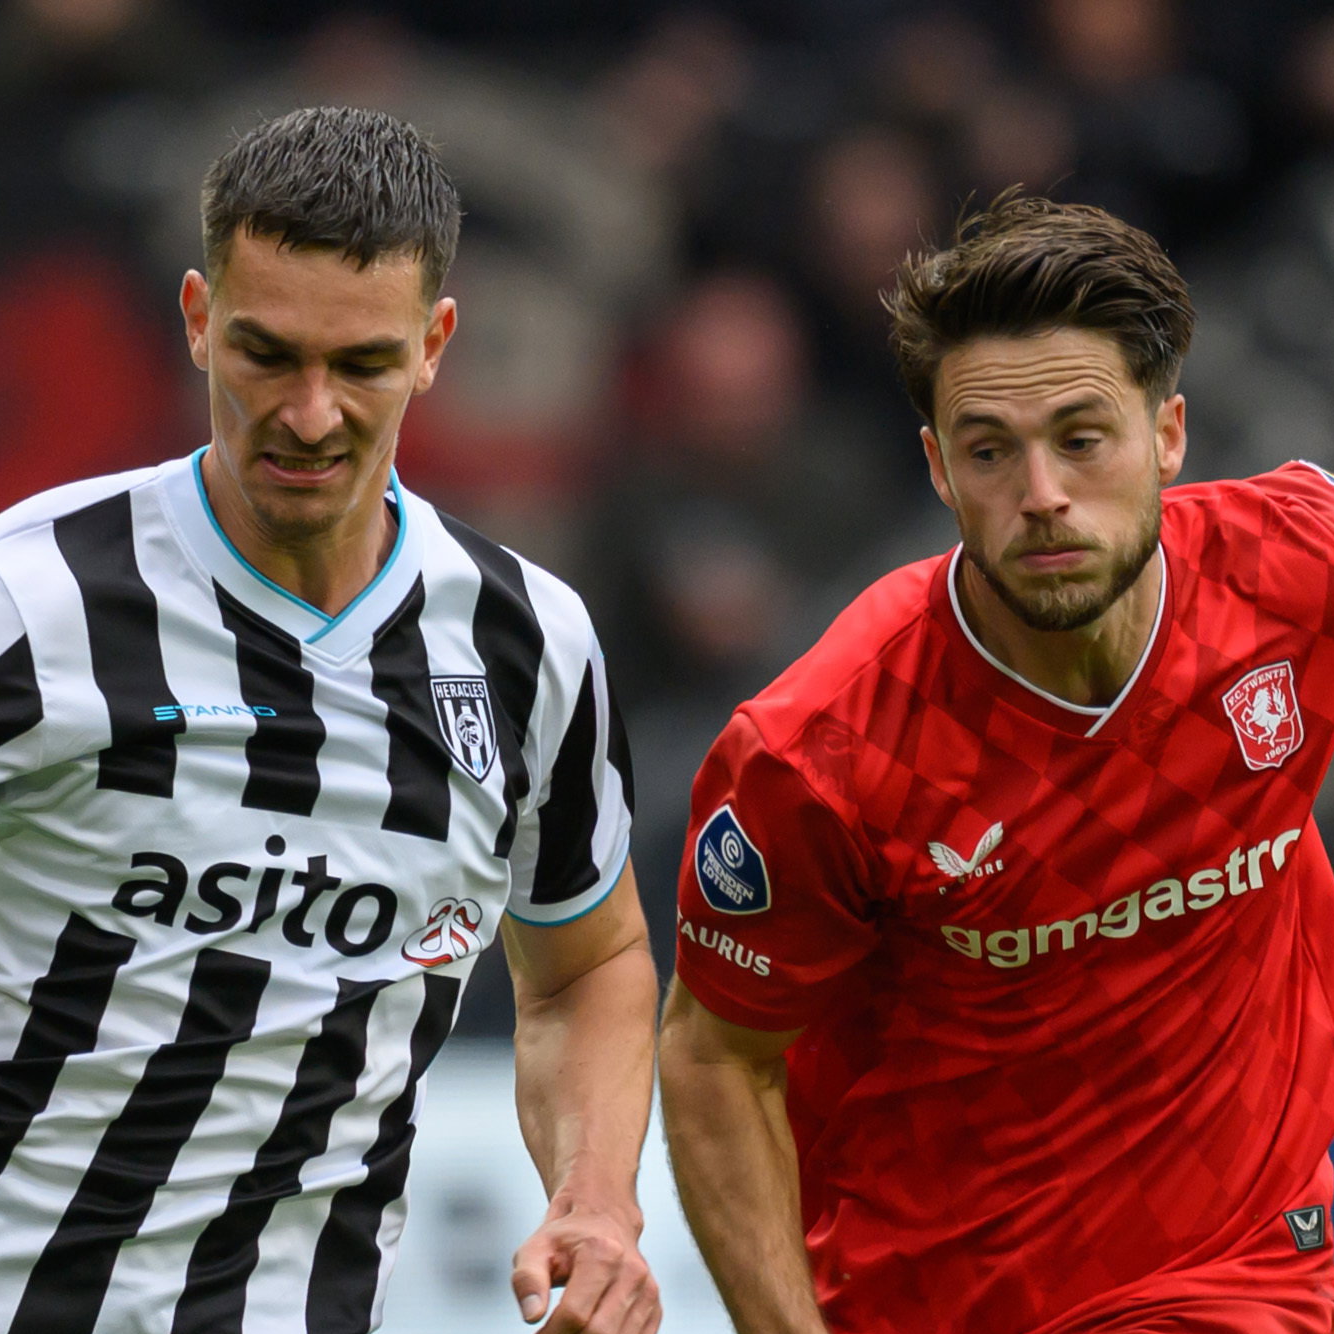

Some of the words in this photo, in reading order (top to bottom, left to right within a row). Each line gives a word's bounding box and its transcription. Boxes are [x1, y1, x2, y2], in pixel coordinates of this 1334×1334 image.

[435, 683, 485, 699] HERACLES
[1243, 667, 1288, 692] TWENTE
[153, 705, 277, 721] STANNO
[704, 842, 754, 901] VRIENDEN
[111, 834, 398, 958] asito
